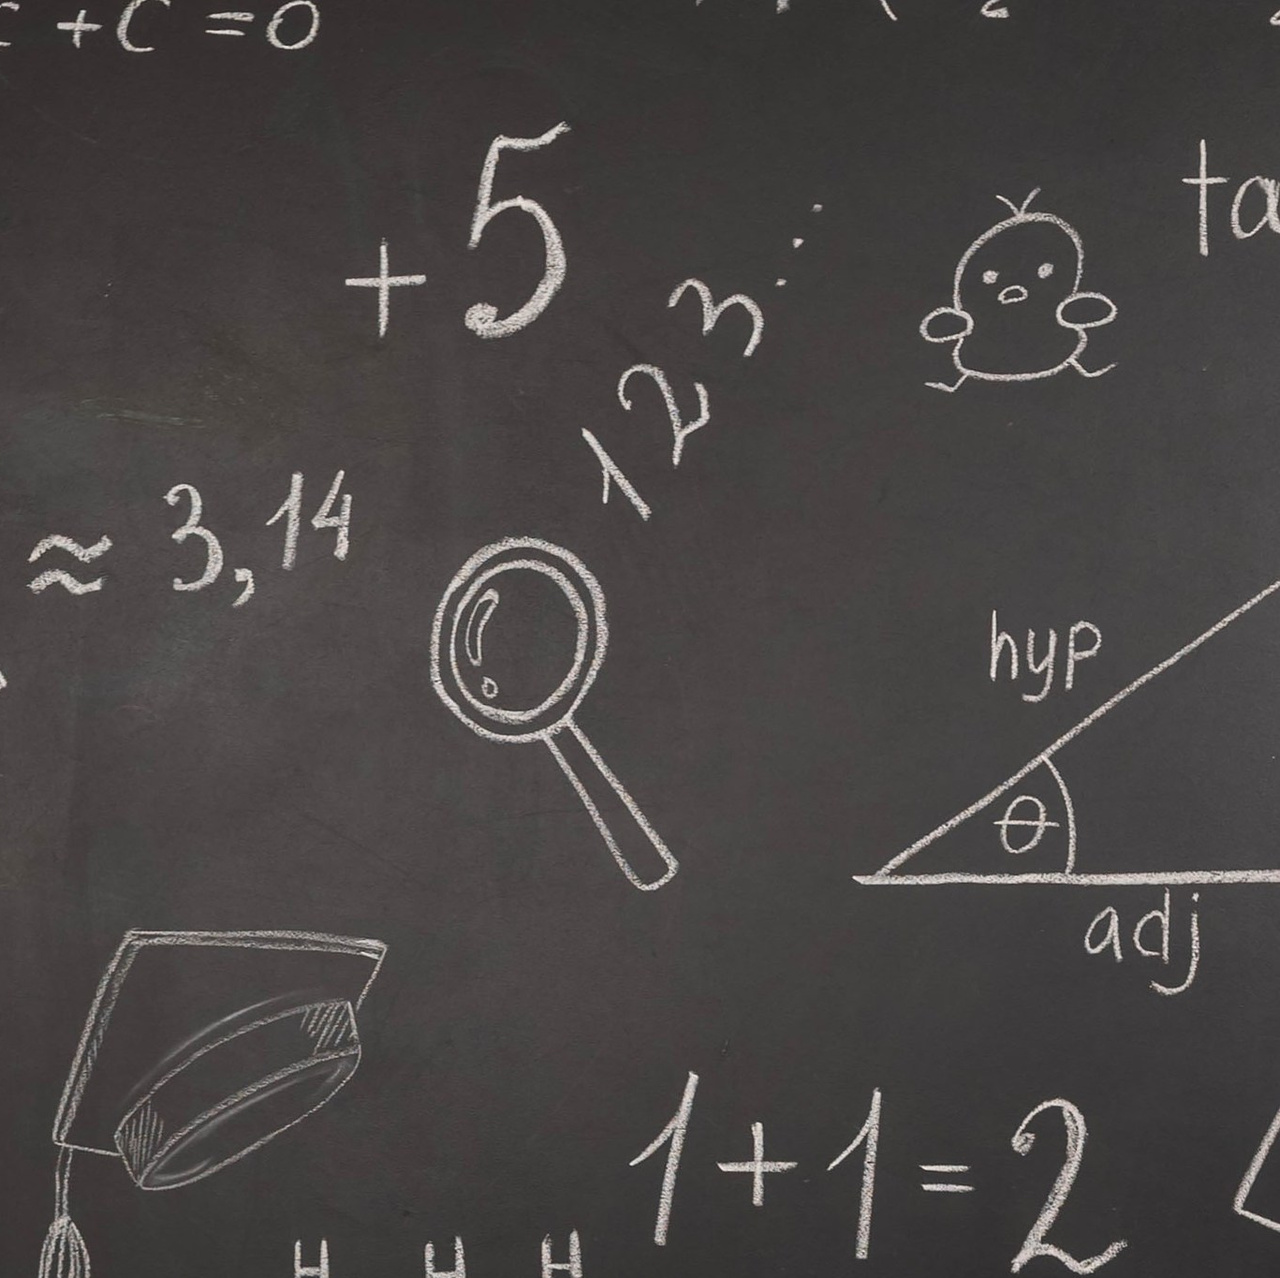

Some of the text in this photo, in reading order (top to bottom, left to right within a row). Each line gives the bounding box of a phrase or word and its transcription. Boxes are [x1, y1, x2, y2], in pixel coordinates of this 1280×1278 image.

[162, 469, 354, 608] 3,14
[988, 609, 1104, 703] hyp
[1083, 887, 1203, 996] adj
